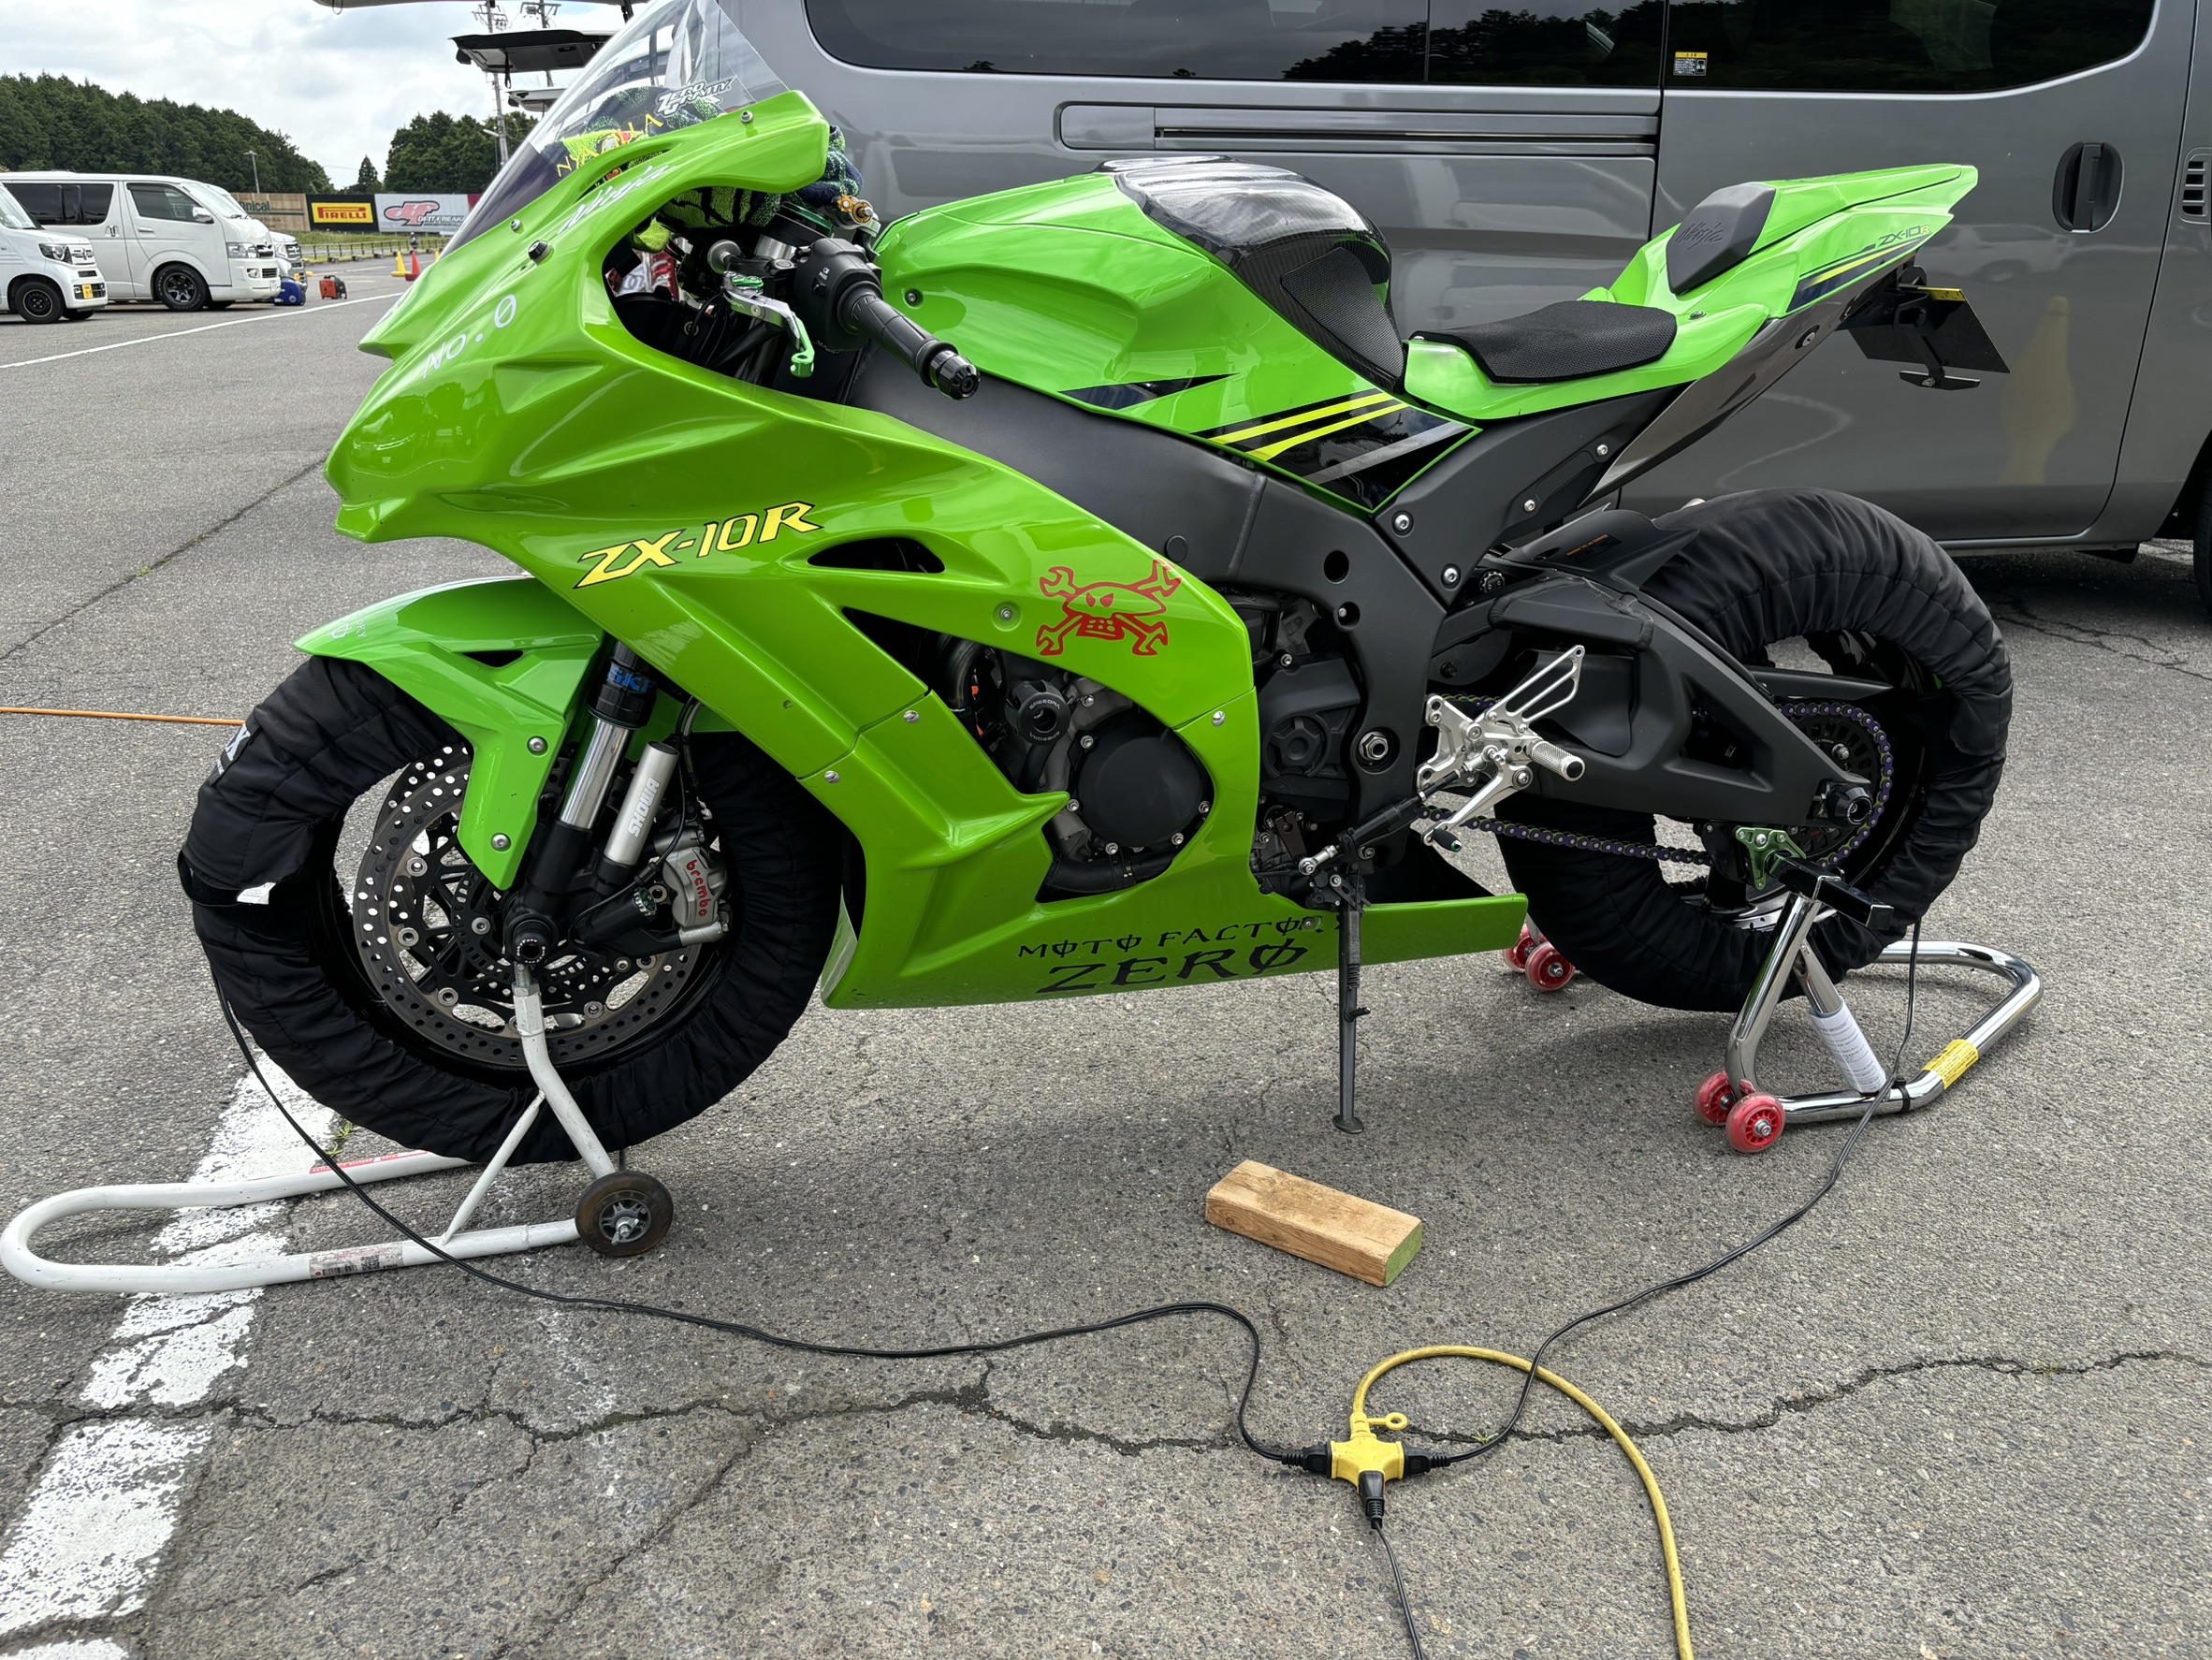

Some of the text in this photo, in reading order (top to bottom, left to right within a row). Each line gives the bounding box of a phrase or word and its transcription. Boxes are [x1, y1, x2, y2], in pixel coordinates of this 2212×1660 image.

[658, 81, 706, 113] ZERO
[316, 207, 367, 219] PIRELLI
[1877, 225, 1932, 247] ZX-10R
[572, 500, 825, 590] ZX-10R
[627, 777, 661, 838] SHOWA
[686, 859, 712, 918] brembo
